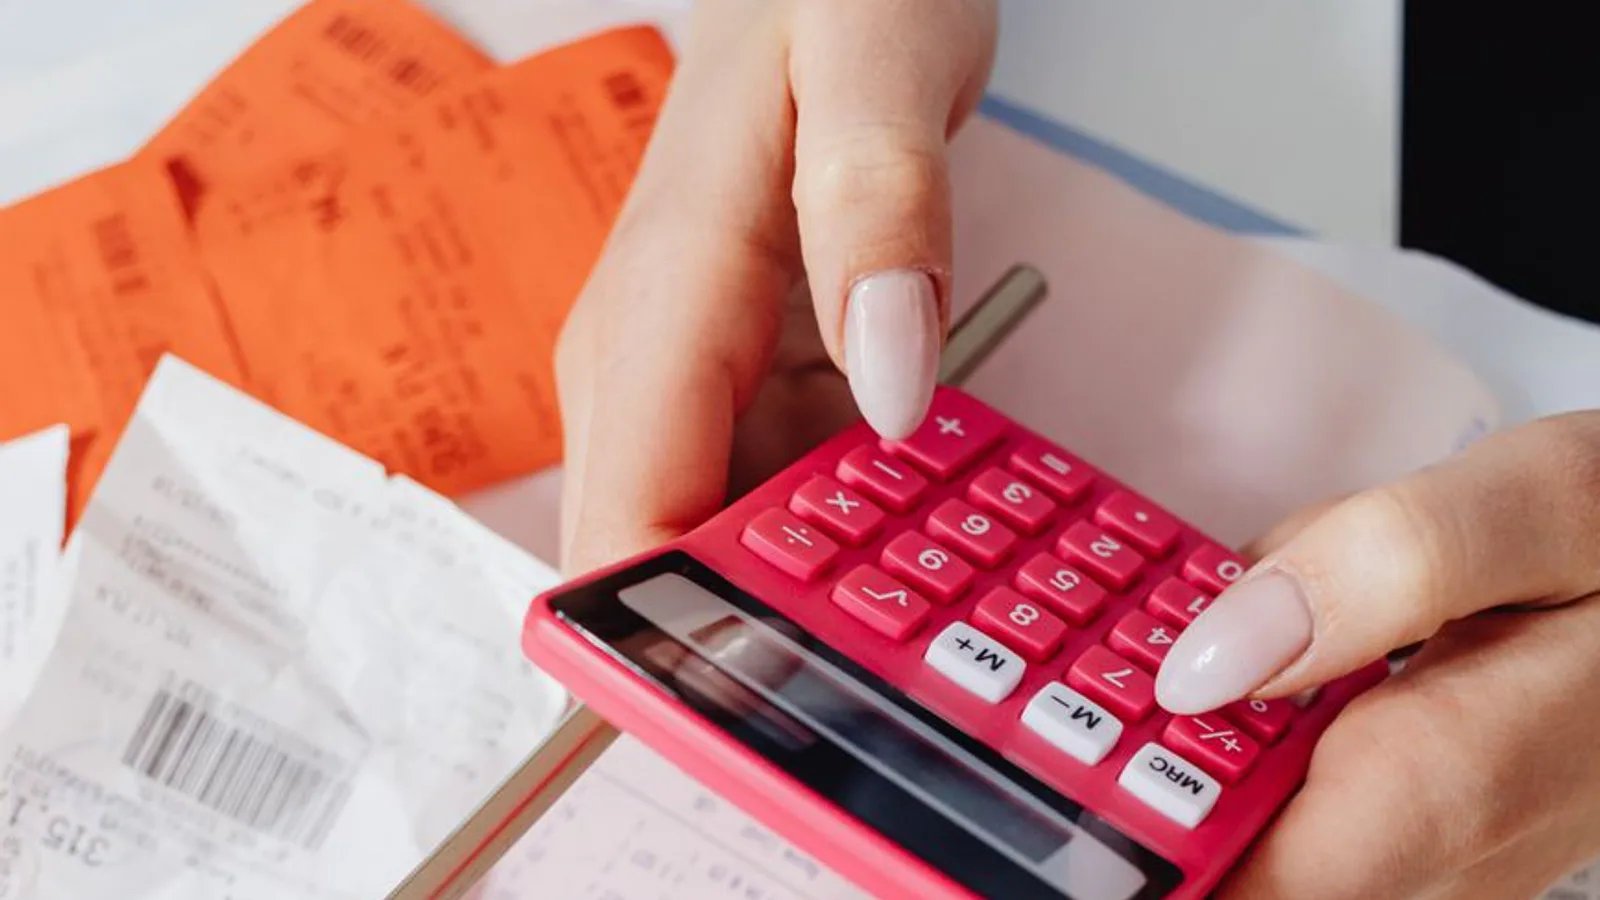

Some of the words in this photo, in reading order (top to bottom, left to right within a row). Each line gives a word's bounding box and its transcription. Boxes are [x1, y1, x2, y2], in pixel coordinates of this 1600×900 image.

[1002, 482, 1032, 504] 3
[960, 514, 991, 536] 6
[1090, 535, 1121, 558] 2
[918, 548, 949, 571] 9
[1216, 560, 1243, 581] 0
[1050, 570, 1081, 592] 5
[1008, 602, 1040, 627] 8
[1145, 627, 1173, 647] 4
[954, 634, 1007, 673] M+
[1102, 666, 1135, 690] 7
[1148, 755, 1204, 797] MRC
[0, 788, 111, 868] 315.1
